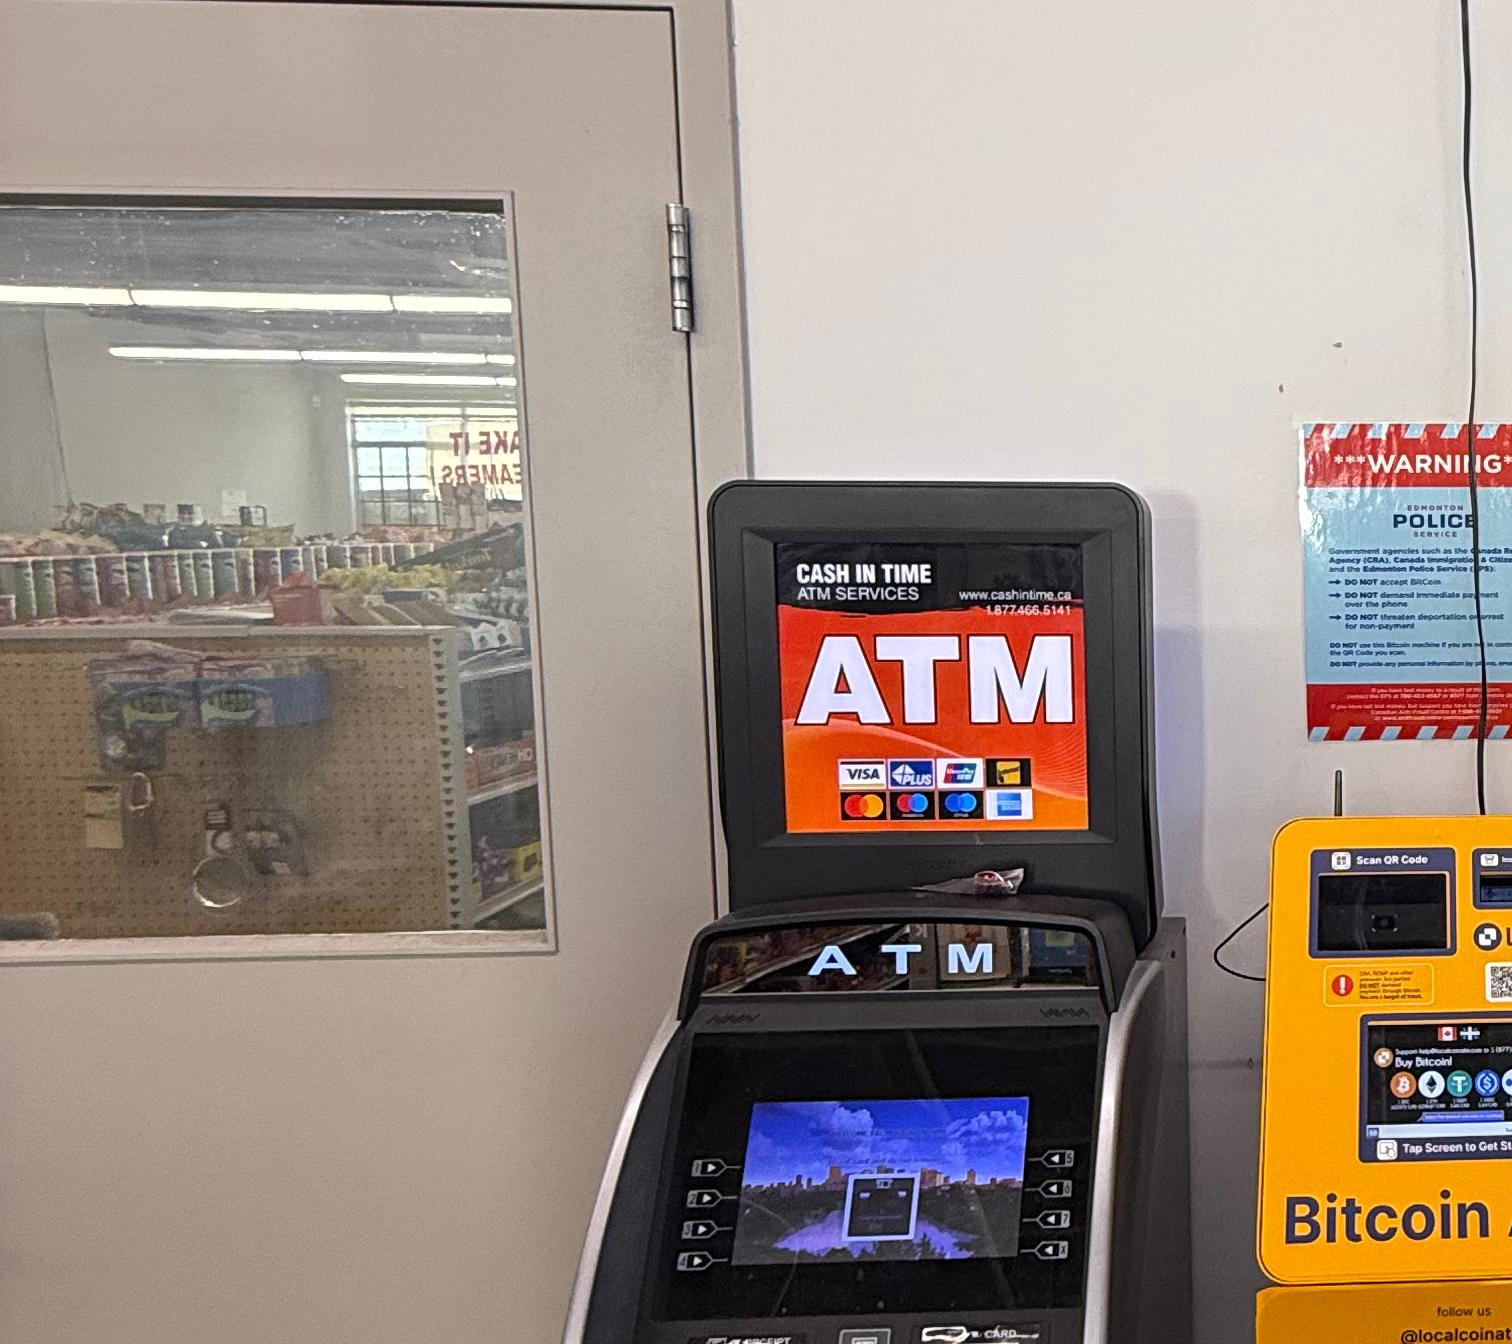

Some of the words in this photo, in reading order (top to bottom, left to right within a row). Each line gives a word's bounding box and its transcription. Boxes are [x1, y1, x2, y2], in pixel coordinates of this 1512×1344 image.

[1393, 514, 1475, 528] POLICE
[796, 564, 849, 583] CASH
[856, 564, 875, 583] IN
[882, 564, 932, 583] TIME
[797, 587, 831, 600] ATM
[835, 587, 919, 600] SERVICES
[959, 590, 1071, 601] www.cashintime.ca
[796, 635, 1075, 725] ATM
[846, 768, 880, 780] VISA
[903, 774, 932, 786] PLUS
[1357, 856, 1382, 865] Scan
[1384, 855, 1399, 865] QR
[1401, 855, 1428, 864] Code
[1395, 1058, 1412, 1068] Buy
[1416, 1057, 1452, 1066] Bitcoin!
[1402, 1144, 1422, 1154] Tap
[1425, 1142, 1462, 1152] Screen
[1465, 1143, 1477, 1152] to
[1479, 1141, 1498, 1151] Get
[1285, 1189, 1490, 1244] Bitcoin
[1436, 1305, 1473, 1318] follow
[1477, 1306, 1492, 1317] us
[985, 1329, 1016, 1338] CARD
